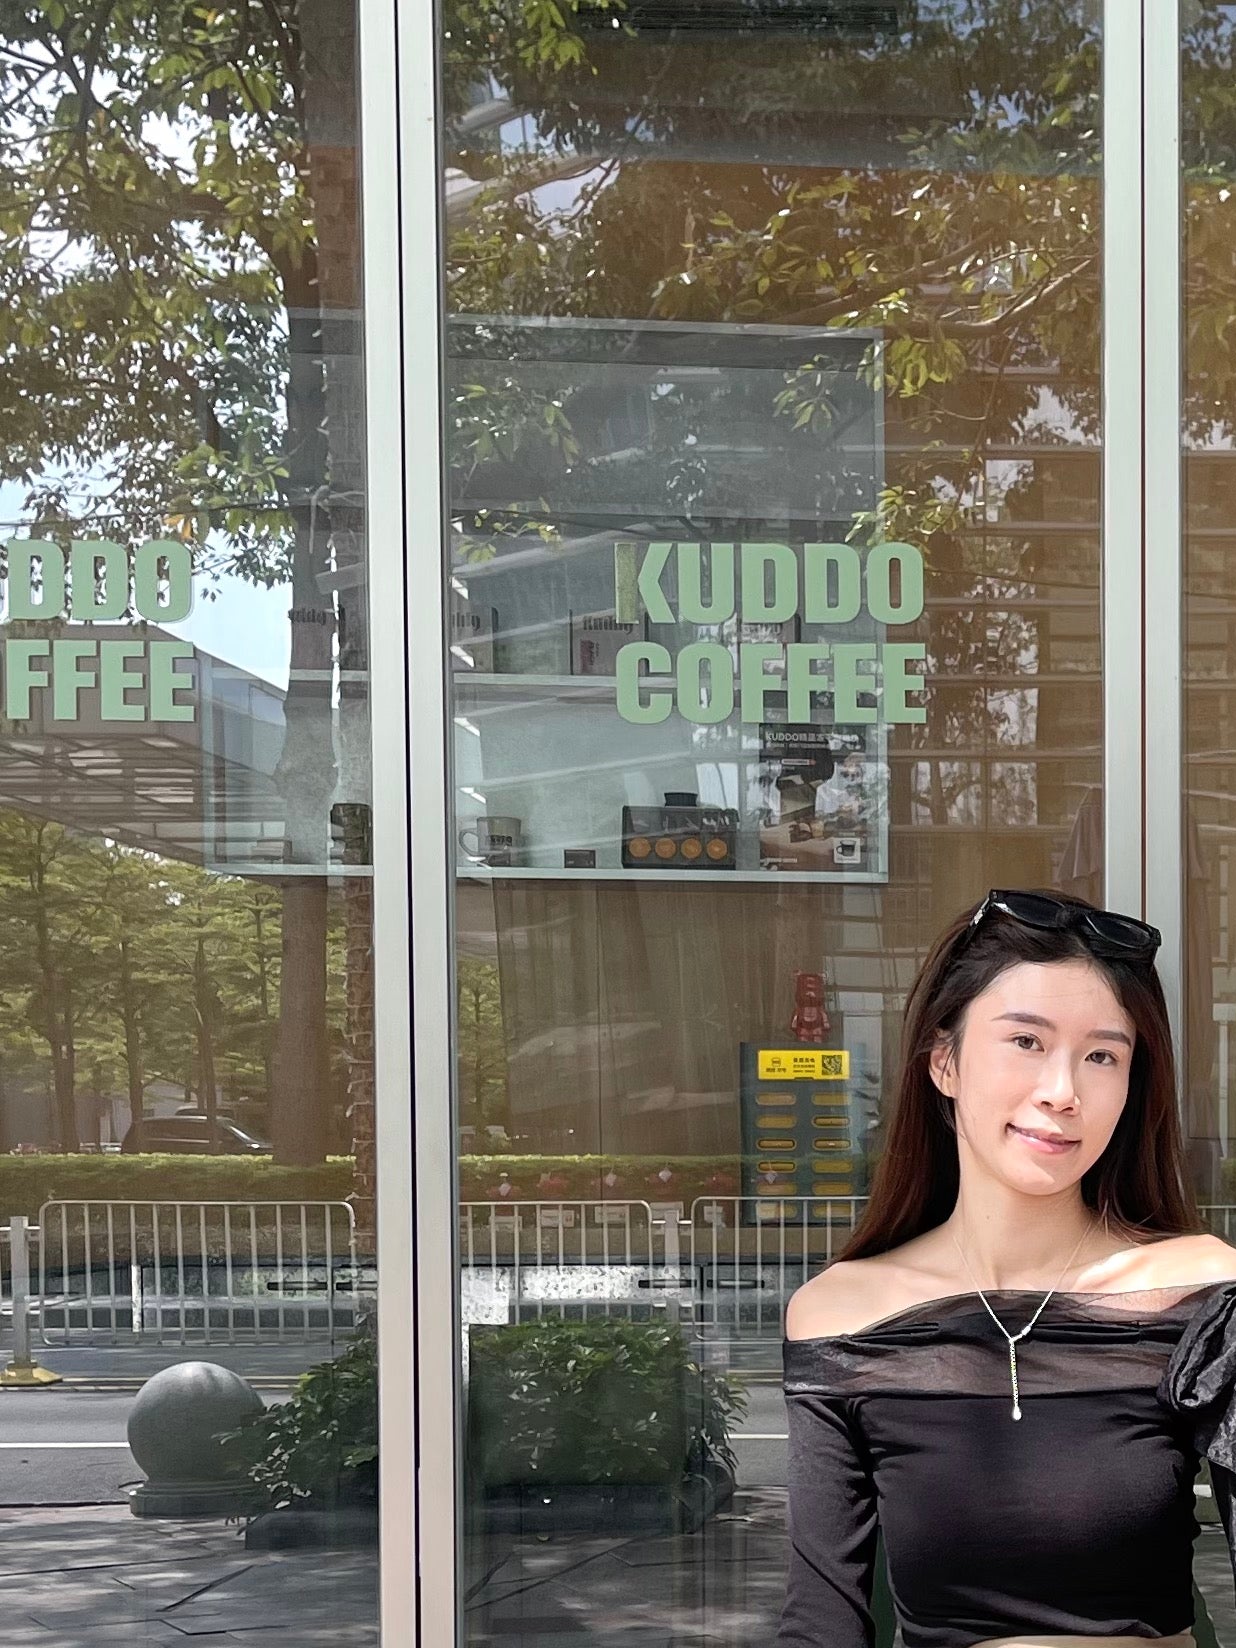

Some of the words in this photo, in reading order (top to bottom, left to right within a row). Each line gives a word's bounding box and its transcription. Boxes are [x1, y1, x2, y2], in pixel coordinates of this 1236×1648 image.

[614, 541, 925, 625] KUDDO
[6, 639, 194, 721] FFEE
[615, 641, 926, 724] COFFEE
